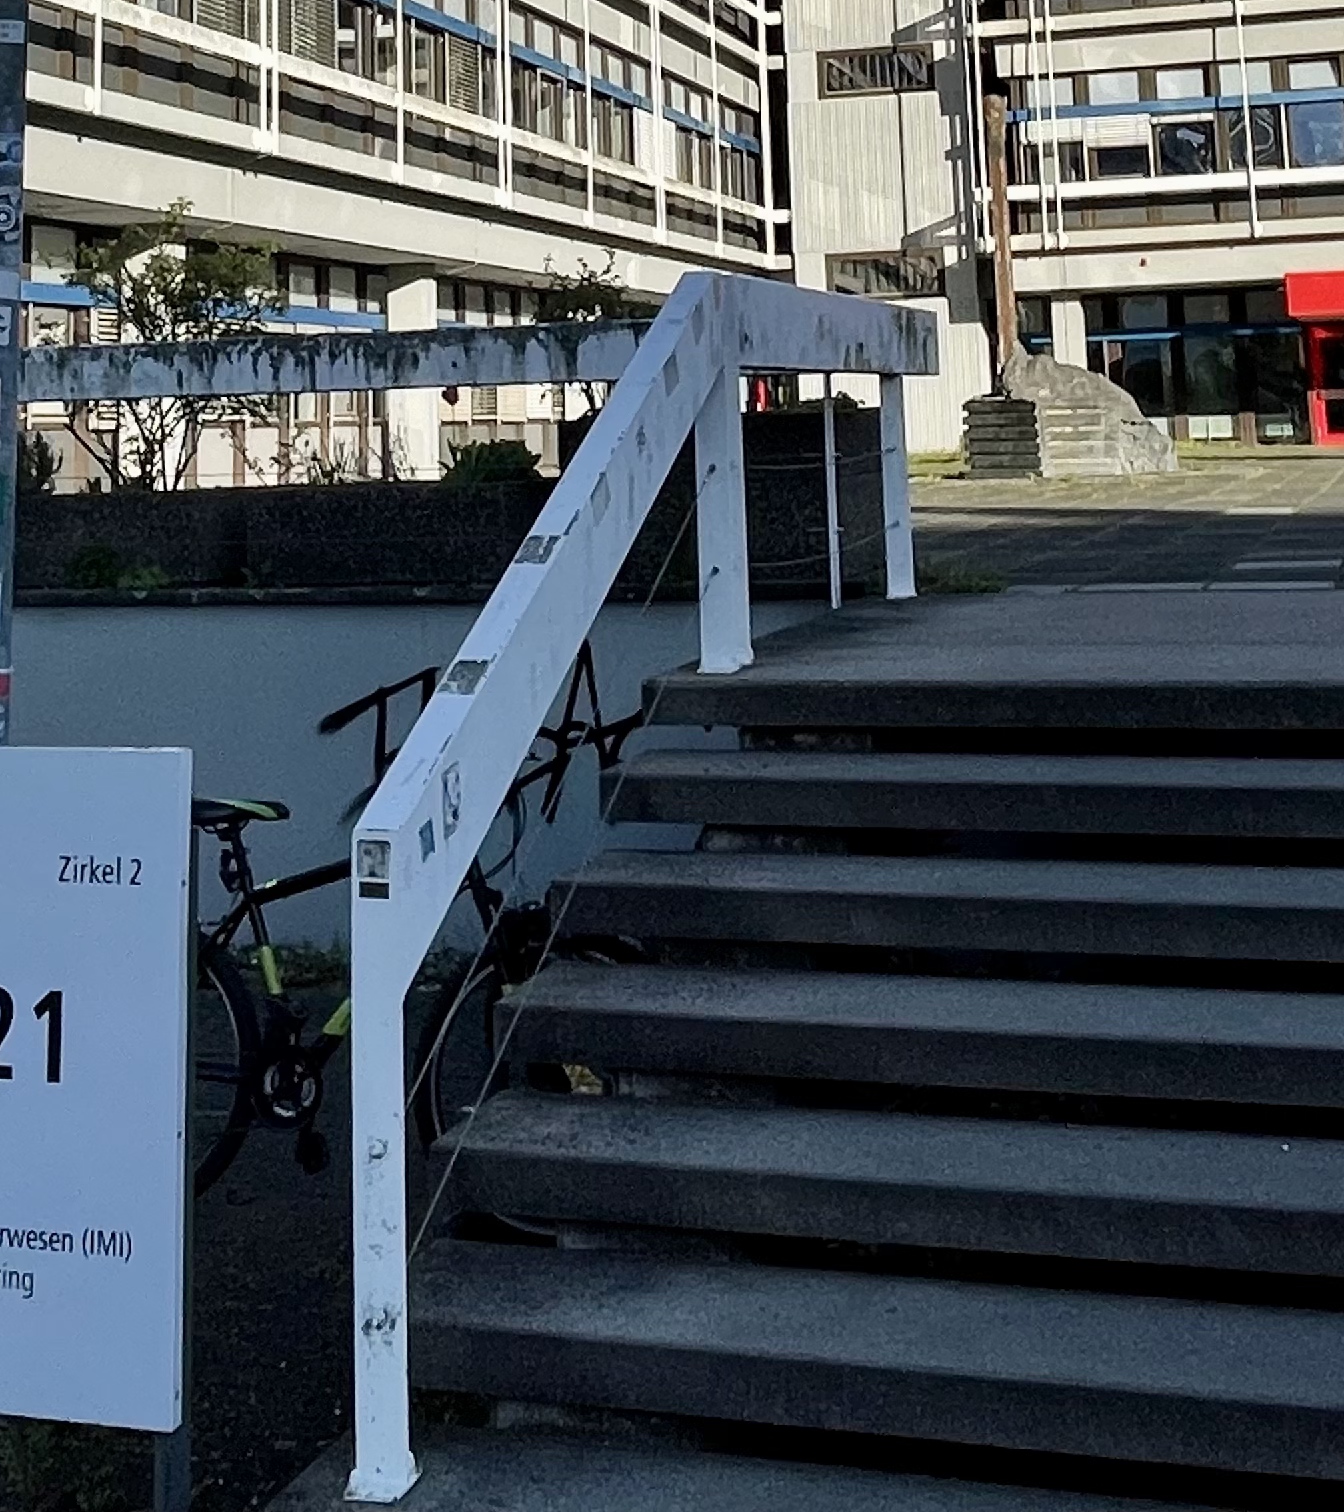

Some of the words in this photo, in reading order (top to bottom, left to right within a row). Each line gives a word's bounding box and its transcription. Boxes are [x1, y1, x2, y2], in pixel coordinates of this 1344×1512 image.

[58, 855, 122, 886] Zirkel
[130, 859, 143, 886] 2
[81, 1227, 133, 1264] (IMI)
